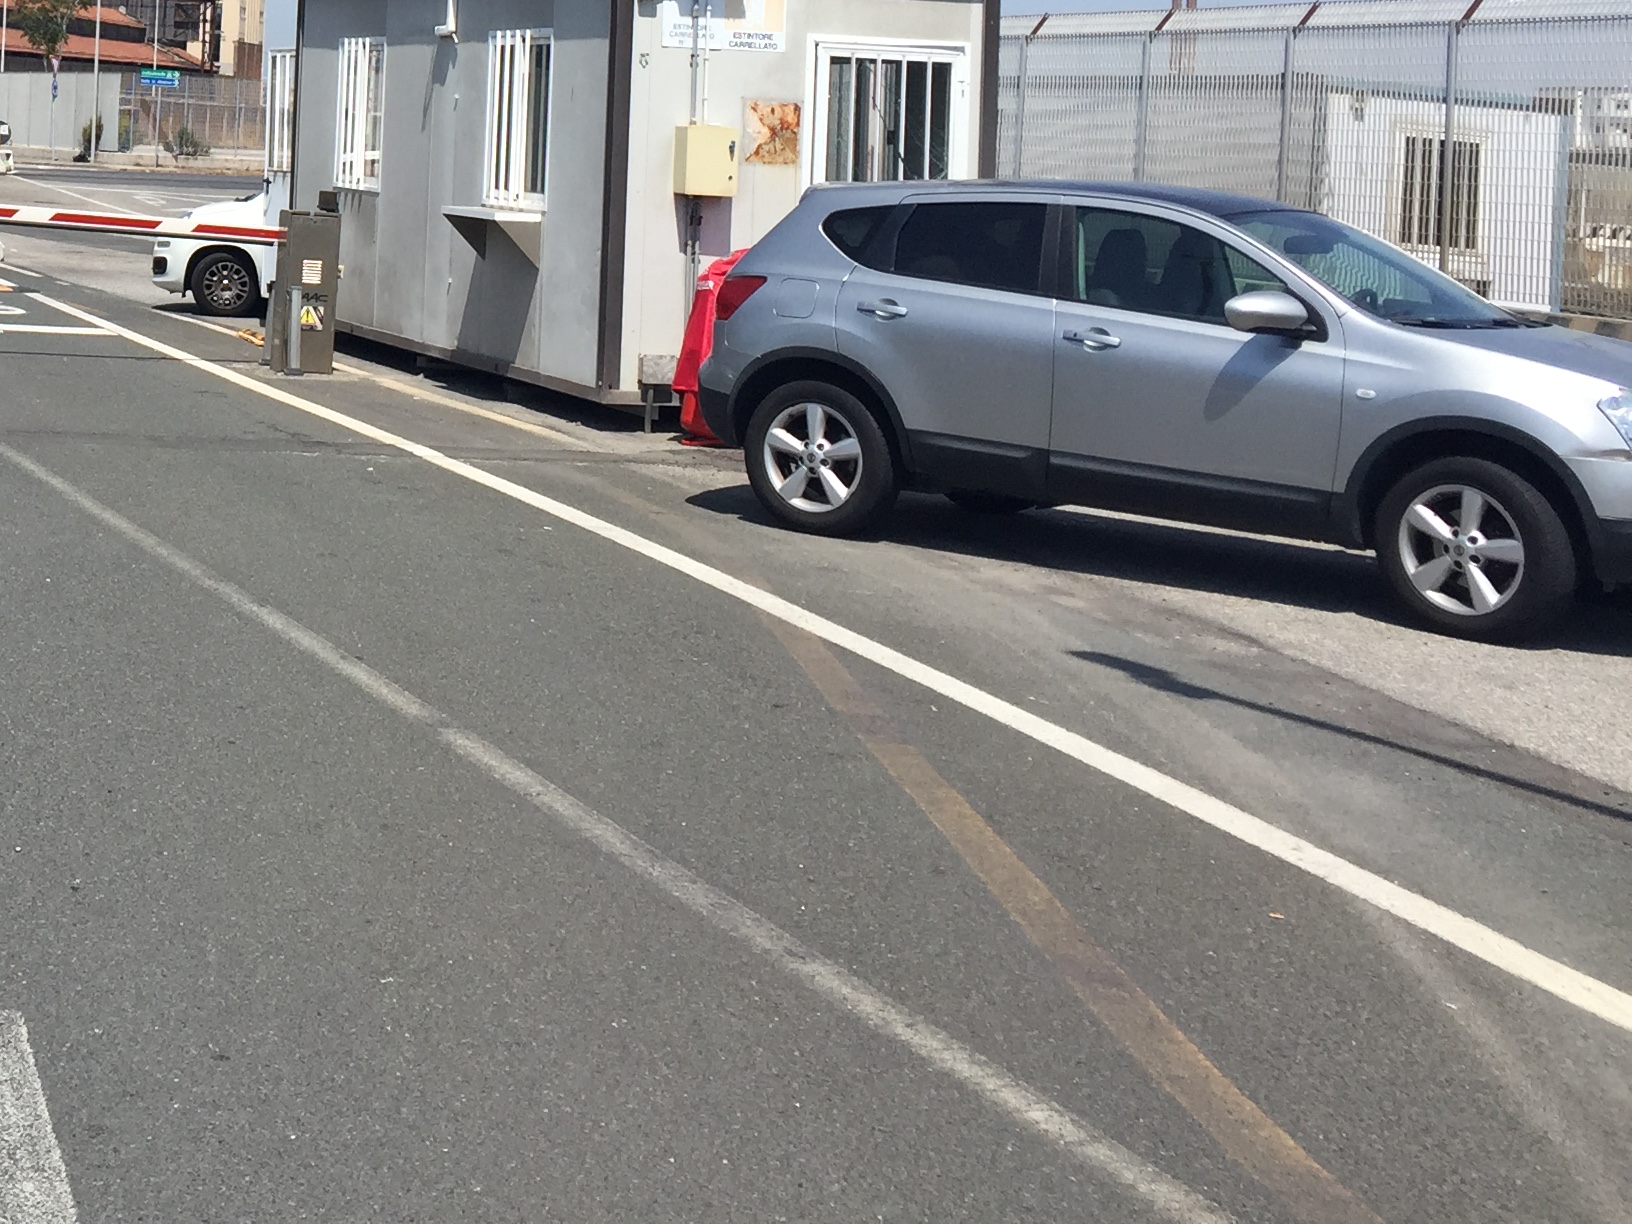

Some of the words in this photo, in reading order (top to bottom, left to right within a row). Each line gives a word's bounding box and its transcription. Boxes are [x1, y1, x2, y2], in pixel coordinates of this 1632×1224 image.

[733, 31, 774, 42] ESTINTORE
[728, 41, 778, 51] CARRELLATO
[301, 293, 328, 302] AAC
